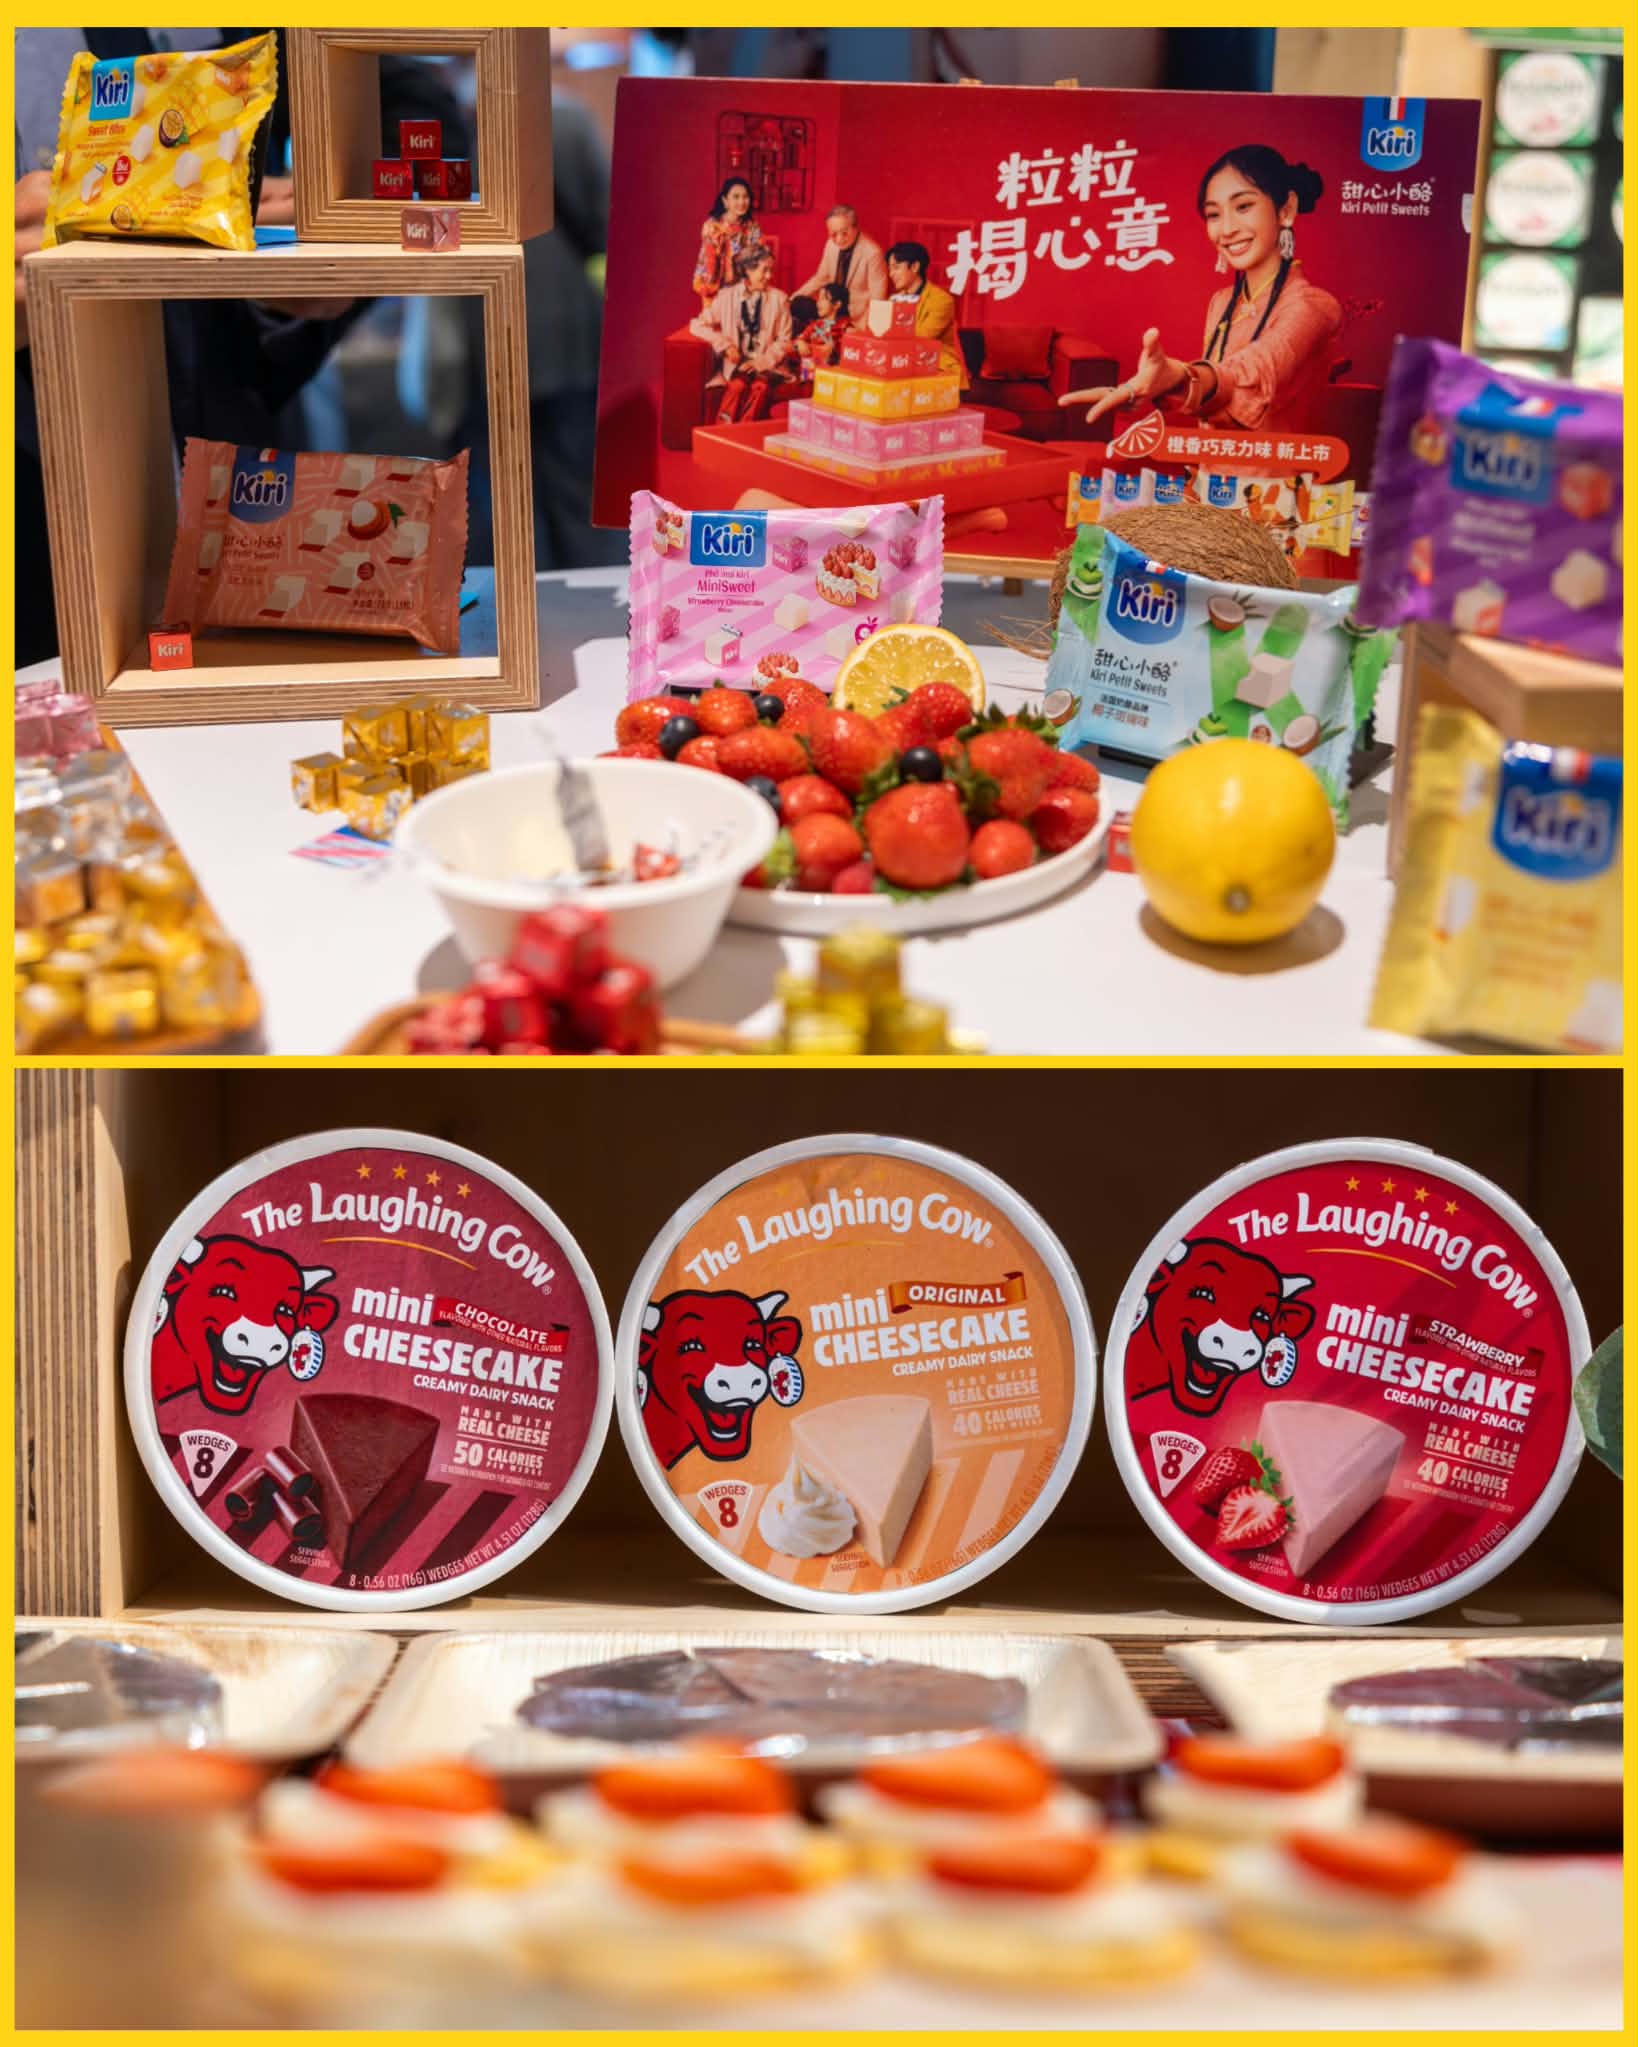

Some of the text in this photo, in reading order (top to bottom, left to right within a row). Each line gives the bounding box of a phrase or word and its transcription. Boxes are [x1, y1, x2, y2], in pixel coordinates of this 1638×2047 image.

[95, 70, 130, 107] Kiri
[409, 135, 434, 149] Kiri
[1367, 127, 1416, 157] Kiri
[379, 173, 404, 188] Kiri
[996, 139, 1138, 210] 粒粒
[1341, 181, 1432, 202] 甜心小酪
[1341, 202, 1431, 216] Kiri Petit Sweets
[406, 223, 428, 239] Kiri
[945, 197, 1175, 301] 揭心意
[1167, 436, 1330, 462] 橙香巧克力味 新上市
[233, 471, 288, 506] Kiri
[702, 523, 755, 557] Kiri
[697, 579, 755, 593] MiniSweet
[1116, 577, 1178, 626] Kiri
[157, 642, 184, 657] Kiri
[1506, 790, 1606, 860] Kiri
[242, 1182, 555, 1288] The Laughing Cow
[684, 1187, 992, 1286] The Laughing Cow
[1228, 1192, 1538, 1311] The Laughing Cow
[351, 1287, 435, 1326] mini
[809, 1288, 889, 1332] mini
[908, 1285, 1006, 1304] ORIGINAL
[455, 1302, 549, 1345] CHOCOLATE
[814, 1308, 1030, 1368] CHEESECAKE
[1325, 1303, 1410, 1347] mini
[343, 1323, 563, 1393] CHEESECAKE
[533, 1342, 562, 1353] FLAVORS
[1428, 1319, 1526, 1367] STRAWBERRY
[892, 1346, 1034, 1377] CREAMY DAIRY SNACK
[1316, 1336, 1536, 1417] CHEESECAKE
[1507, 1364, 1537, 1377] FLAVORS
[413, 1374, 555, 1412] CREAMY DAIRY SNACK
[947, 1380, 1039, 1405] REAL CHEESE
[460, 1405, 552, 1430] MADE WITH
[953, 1404, 1041, 1436] 40 CALORIES
[1383, 1387, 1526, 1434] CREAMY DAIRY SNACK
[187, 1434, 231, 1452] WEDGES
[457, 1416, 550, 1446] REAL CHEESE
[1157, 1435, 1200, 1456] WEDGES
[1428, 1421, 1520, 1453] MADE WITH
[193, 1447, 215, 1478] 8
[453, 1440, 545, 1469] 50 CALORIES
[1161, 1449, 1183, 1480] 8
[1424, 1432, 1517, 1469] REAL CHEESE
[1417, 1458, 1510, 1491] 40 CALORIES
[704, 1484, 747, 1500] WEDGES
[718, 1497, 739, 1528] 8
[349, 1574, 357, 1587] 8
[363, 1576, 384, 1589] 0.56
[387, 1575, 400, 1588] OZ
[402, 1570, 427, 1590] (16G)
[427, 1559, 465, 1582] WEDGES
[464, 1551, 483, 1569] NET
[481, 1544, 496, 1559] WT
[494, 1532, 514, 1551] 4.51
[511, 1522, 526, 1537] OZ
[521, 1498, 549, 1528] (128G)
[1302, 1583, 1310, 1595] 8
[1316, 1585, 1338, 1600] 0.56
[1340, 1587, 1353, 1600] OZ
[1355, 1584, 1381, 1600] (16G)
[1380, 1575, 1420, 1596] WEDGES
[1419, 1569, 1439, 1586] NET
[1437, 1562, 1452, 1578] WT
[1452, 1551, 1471, 1570] 4.51
[1468, 1543, 1484, 1559] OZ
[1479, 1520, 1511, 1551] (128G)
[1249, 1561, 1288, 1577] SUGGESTION
